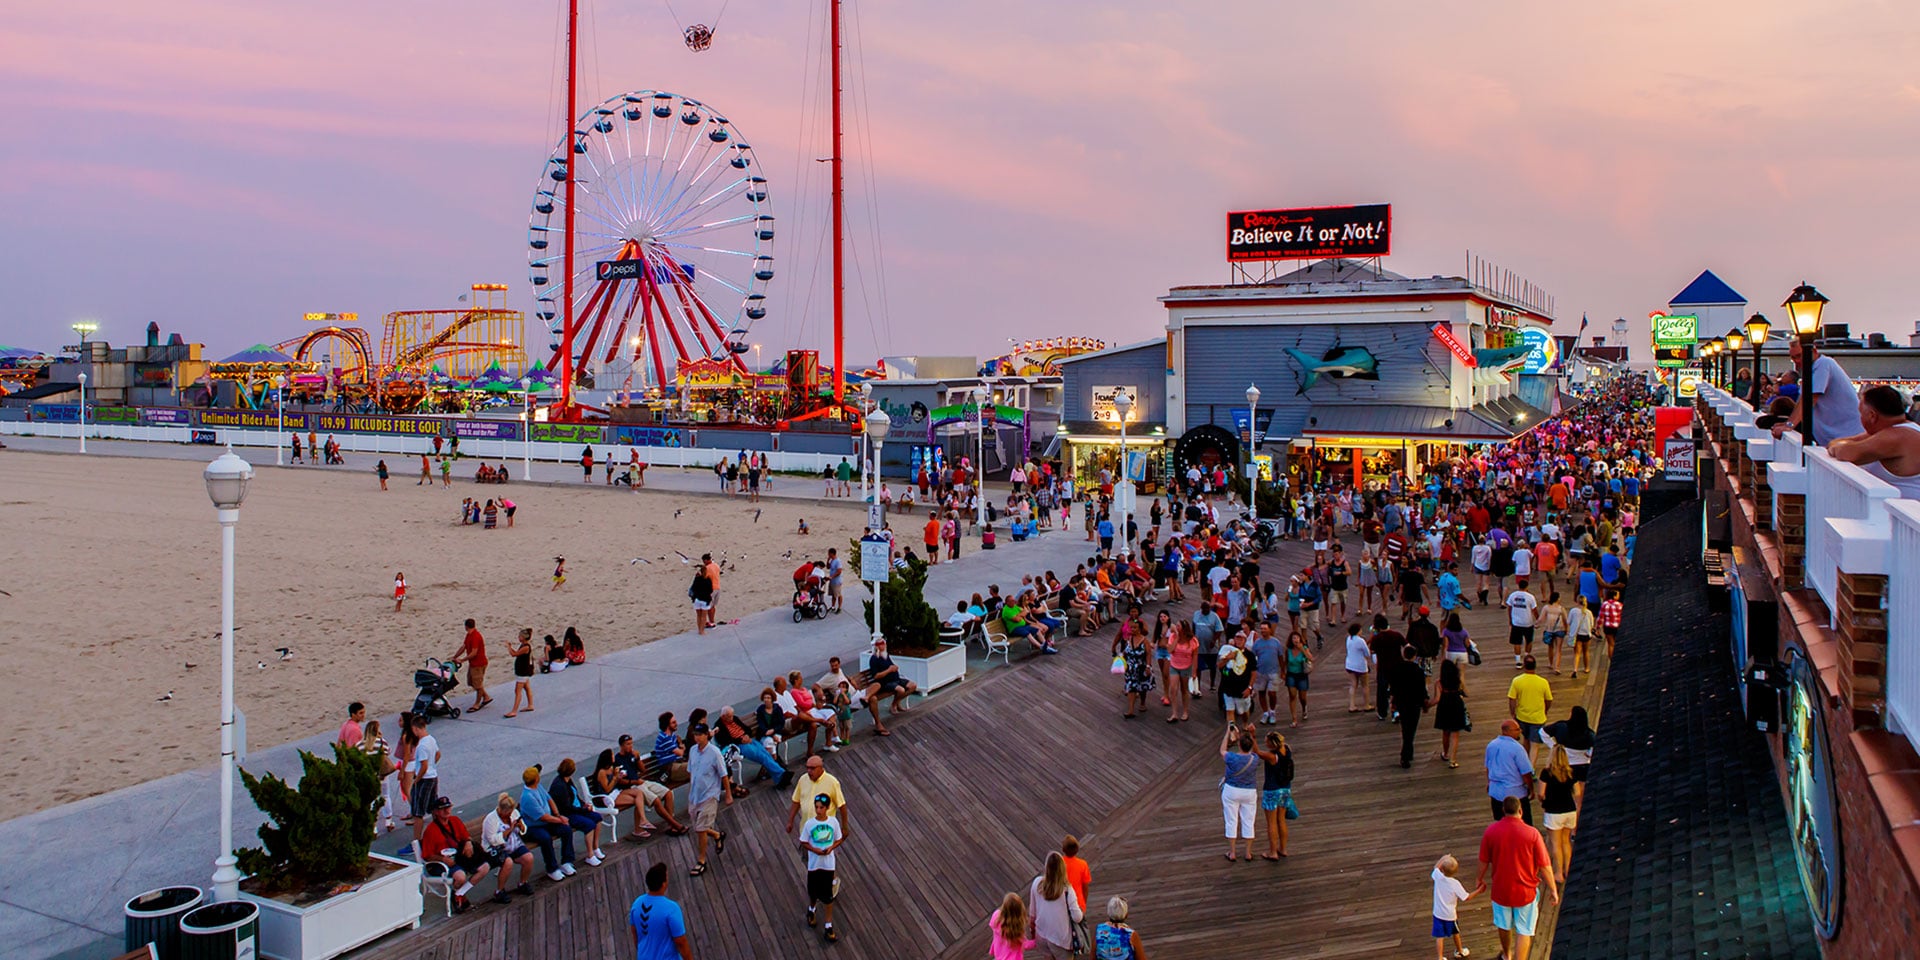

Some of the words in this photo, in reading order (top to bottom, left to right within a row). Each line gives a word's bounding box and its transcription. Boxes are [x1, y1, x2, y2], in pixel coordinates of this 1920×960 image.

[1230, 227, 1293, 245] Believe
[1297, 225, 1314, 242] It
[1319, 228, 1340, 241] or
[1341, 221, 1383, 240] Not!
[613, 263, 636, 275] pepsi
[201, 412, 240, 424] Unlimited
[241, 414, 263, 426] Rides
[264, 415, 280, 426] Arm
[283, 415, 304, 428] Band
[320, 417, 346, 430] $19.99
[350, 418, 392, 432] INCLUDES
[394, 419, 416, 433] FREE
[418, 421, 441, 434] GOLF
[200, 433, 215, 441] pepsi
[1666, 460, 1694, 468] HOTEL
[1505, 506, 1516, 515] 25
